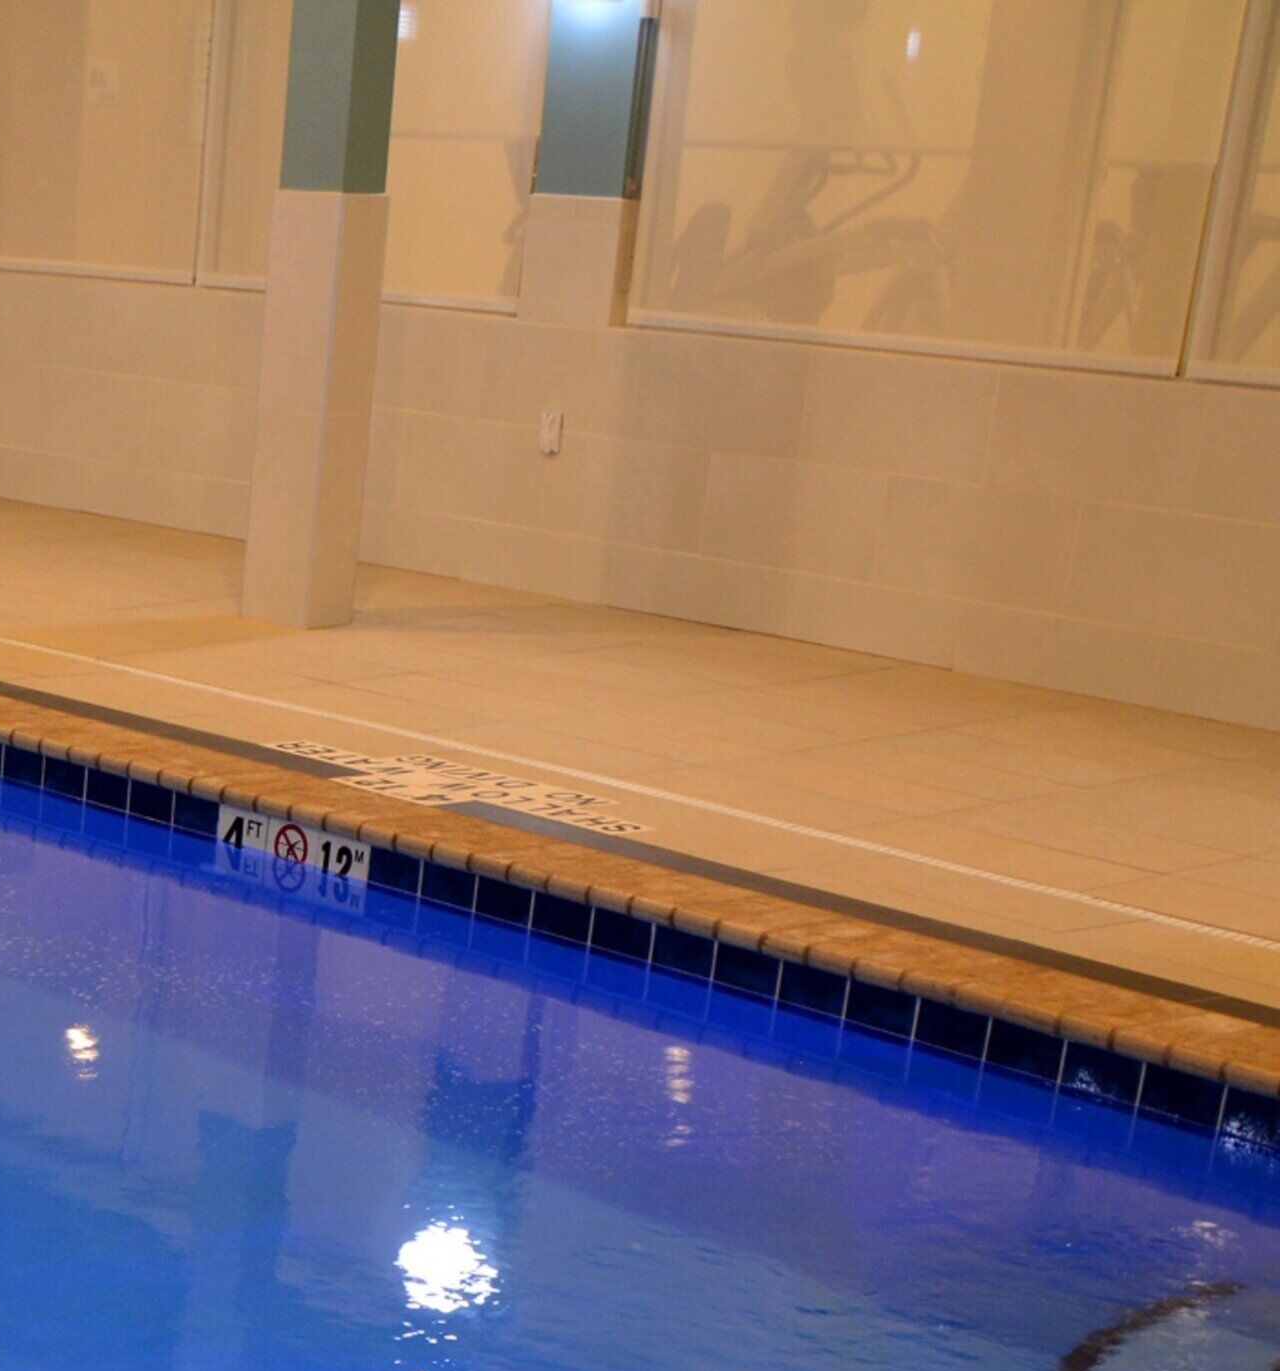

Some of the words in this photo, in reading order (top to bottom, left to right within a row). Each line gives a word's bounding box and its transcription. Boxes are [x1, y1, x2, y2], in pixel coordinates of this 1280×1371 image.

[276, 740, 414, 776] WATER
[396, 753, 537, 789] DIVING
[428, 781, 642, 833] SHALLOW
[544, 790, 604, 807] NO
[222, 816, 245, 850] 4
[246, 819, 263, 838] FT
[354, 849, 365, 865] M
